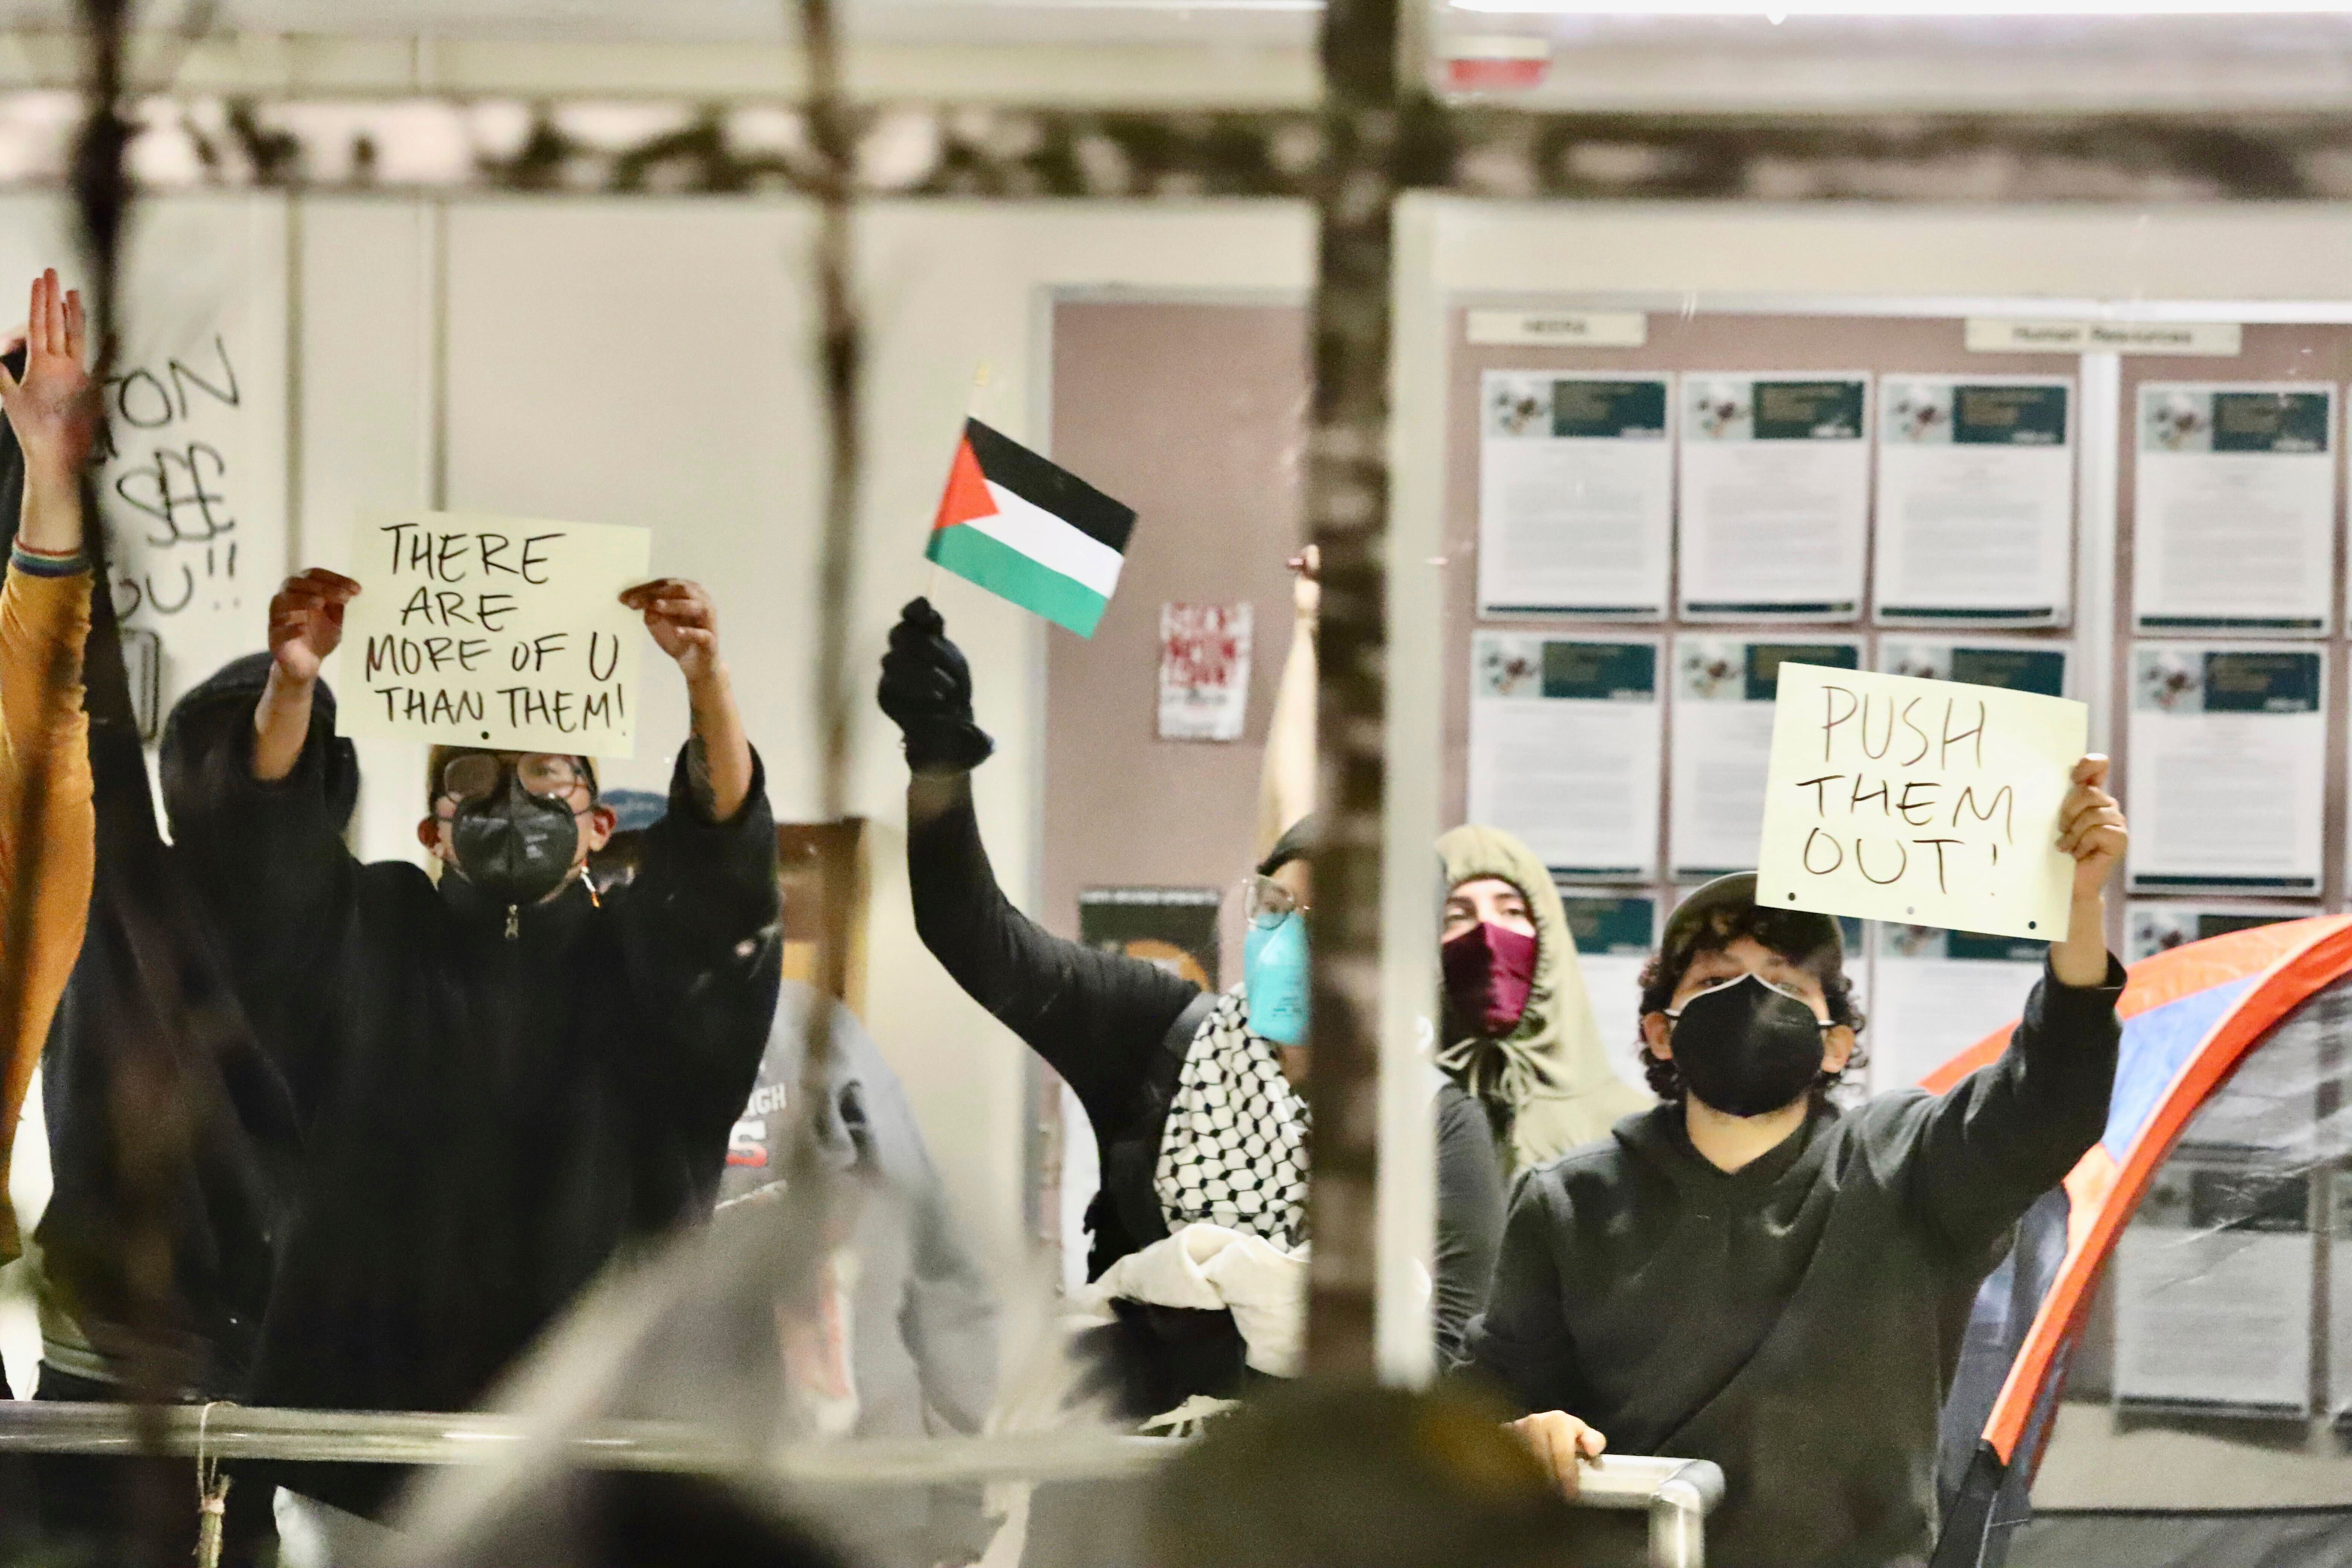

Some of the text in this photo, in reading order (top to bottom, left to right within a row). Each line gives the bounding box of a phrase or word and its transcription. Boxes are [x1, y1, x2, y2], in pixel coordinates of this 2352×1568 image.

[380, 523, 567, 585] THERE
[400, 586, 519, 632] ARE
[364, 630, 620, 683] MORE OF U
[374, 682, 629, 738] THAN THEM!
[1820, 685, 1986, 771] PUSH
[1795, 772, 2014, 846] THEM
[1802, 825, 2000, 898] OUT!
